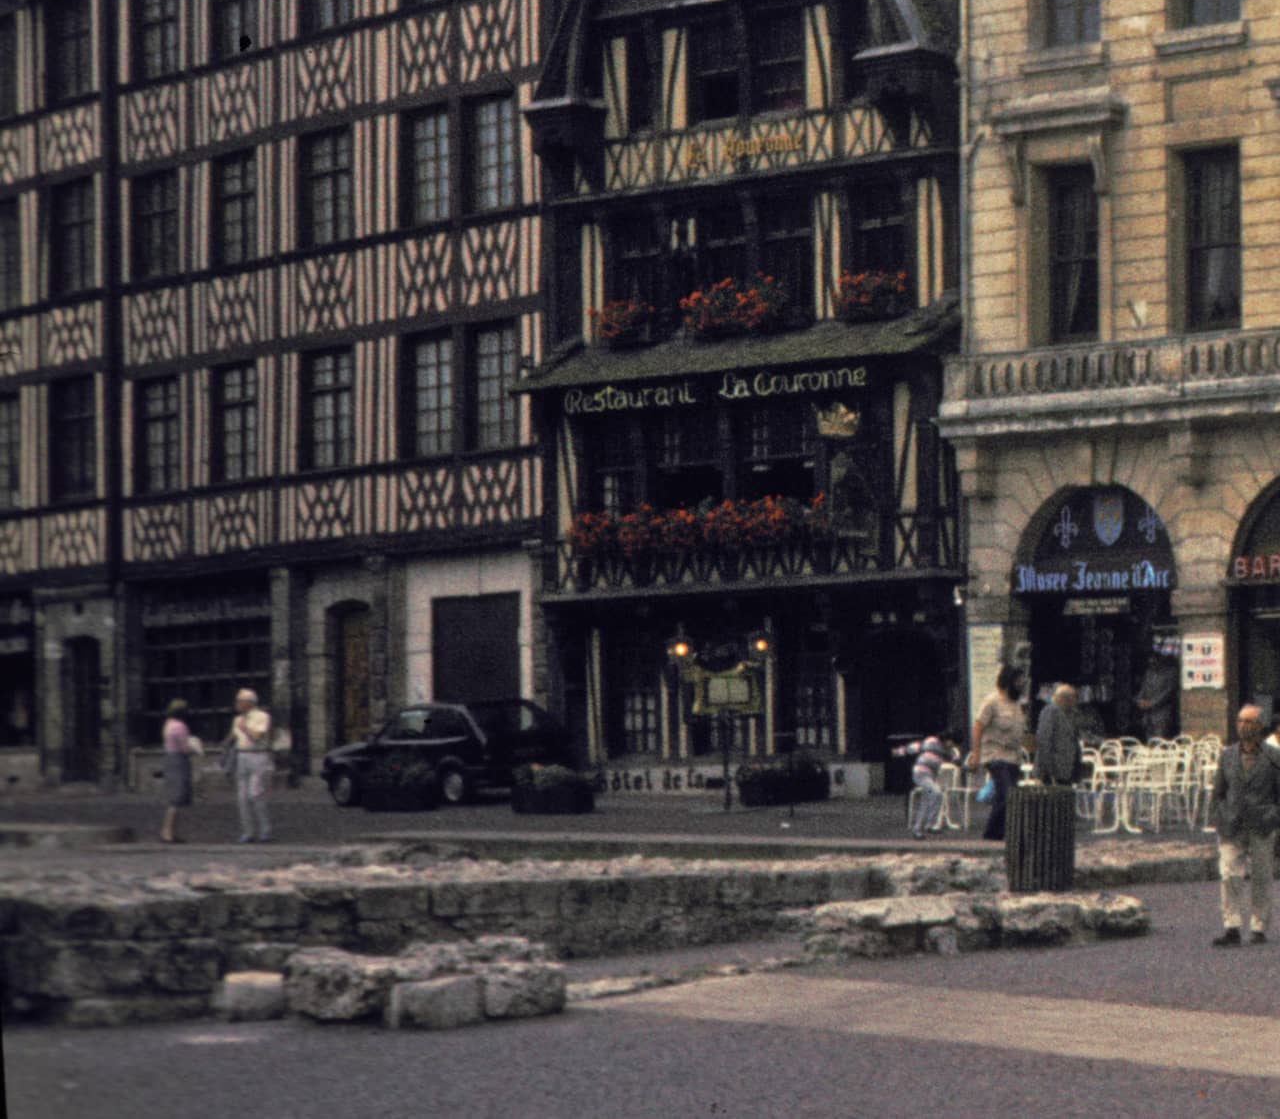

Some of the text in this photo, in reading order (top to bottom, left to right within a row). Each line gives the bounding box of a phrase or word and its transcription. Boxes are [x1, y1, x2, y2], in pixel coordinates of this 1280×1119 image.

[563, 366, 867, 415] Restaurant La Couronne
[1072, 560, 1129, 591] Jeanne
